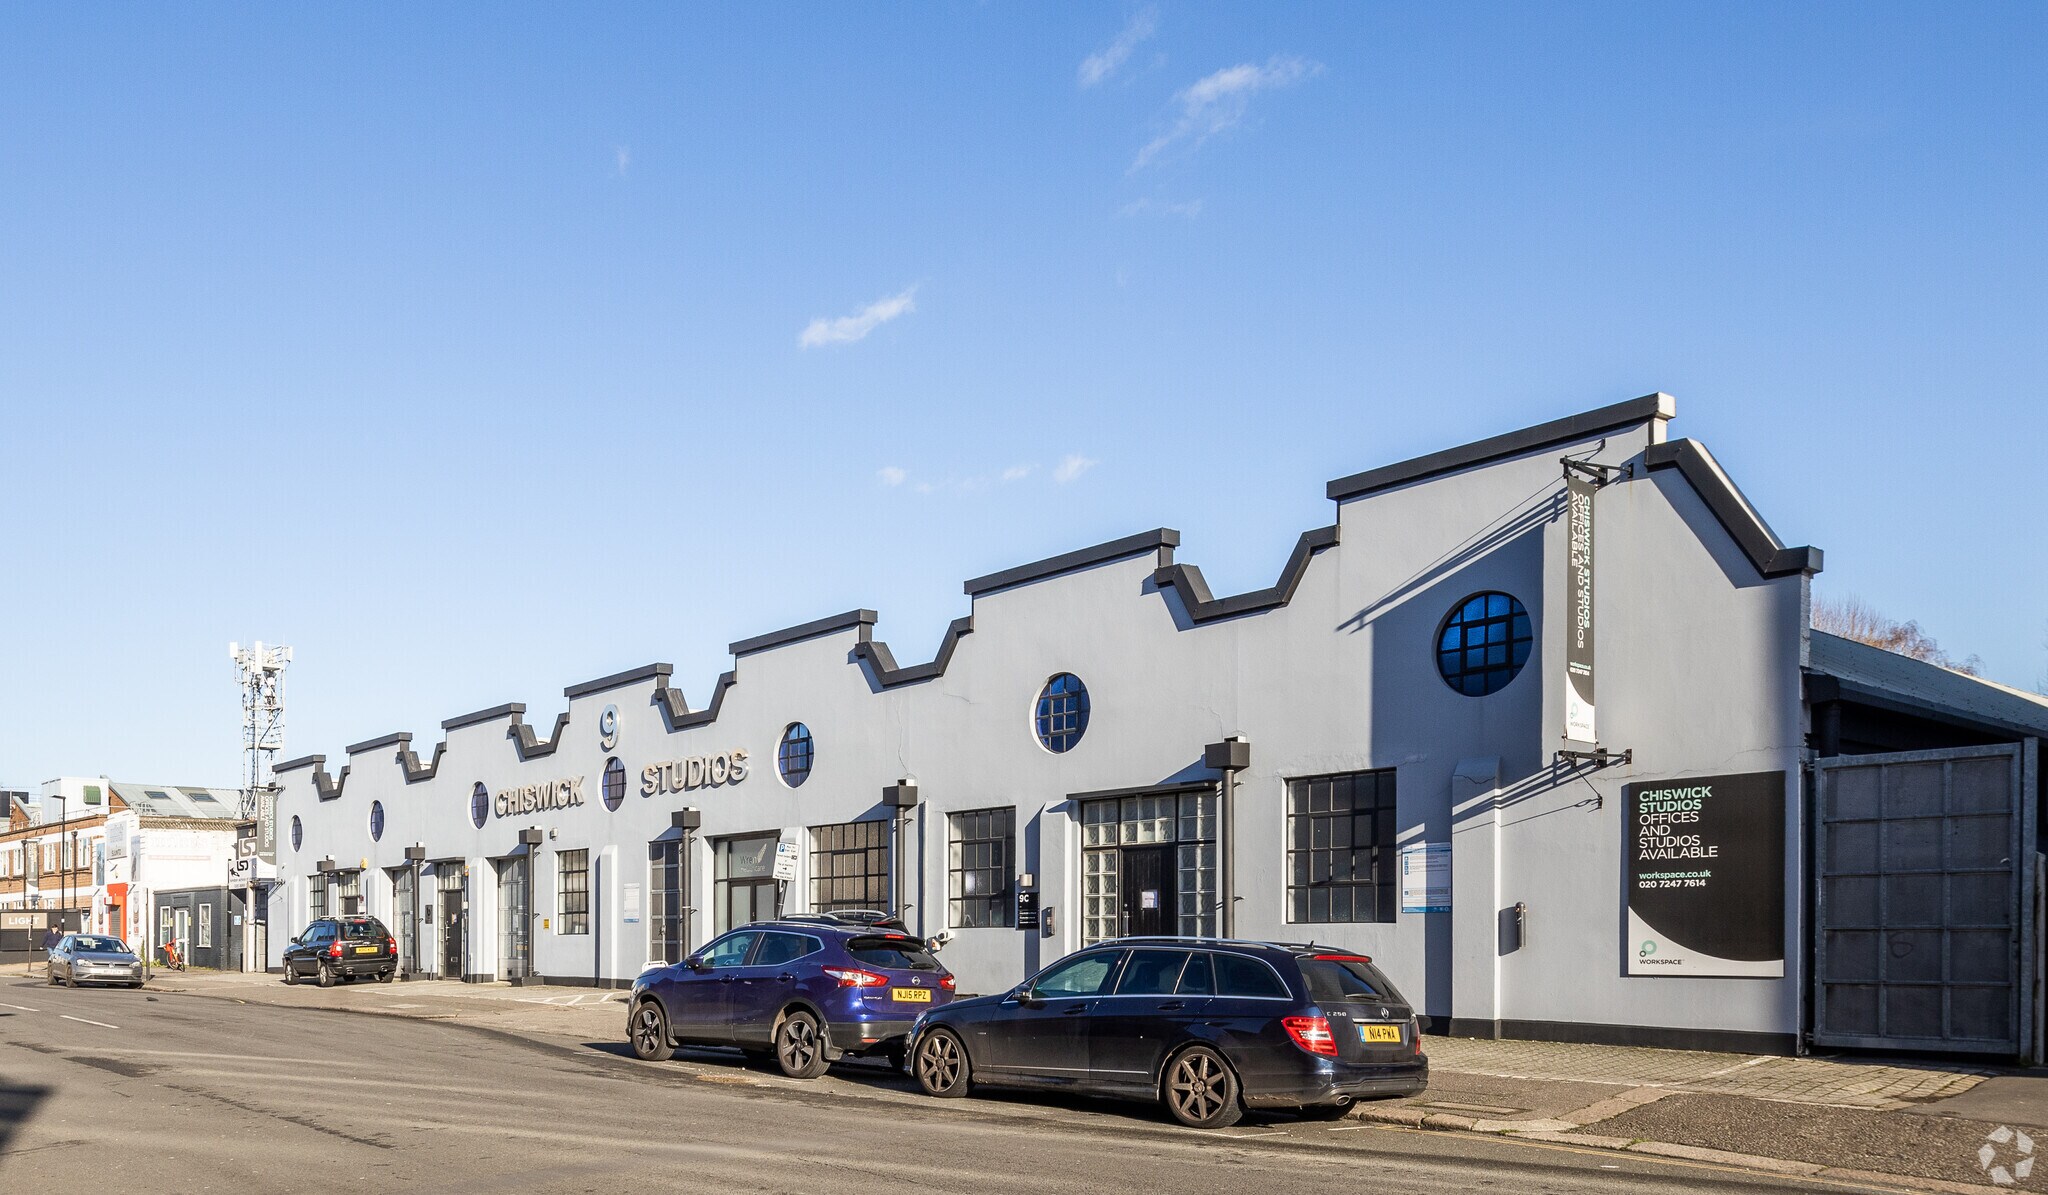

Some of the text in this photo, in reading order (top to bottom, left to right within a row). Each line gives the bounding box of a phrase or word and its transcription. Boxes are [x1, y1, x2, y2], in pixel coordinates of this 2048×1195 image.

[1571, 490, 1579, 567] AVAILABLE
[1583, 495, 1591, 565] CHISWICK
[1577, 493, 1585, 649] OFFICES AND STUDIOS
[601, 703, 621, 750] 9
[495, 748, 749, 816] CHISWICK STUDIOS
[1639, 785, 1712, 802] CHISWICK
[1639, 799, 1703, 813] STUDIOS
[1639, 811, 1699, 825] OFFICES
[1639, 824, 1671, 837] AND
[1639, 834, 1701, 849] STUDIOS
[1638, 845, 1719, 860] AVAILABLE
[1638, 869, 1712, 880] workspace.co.uk
[1638, 878, 1706, 888] 020 7247 7614
[1019, 894, 1029, 903] 9C
[897, 990, 927, 999] NJ15 RPZ
[1369, 1026, 1381, 1040] N14
